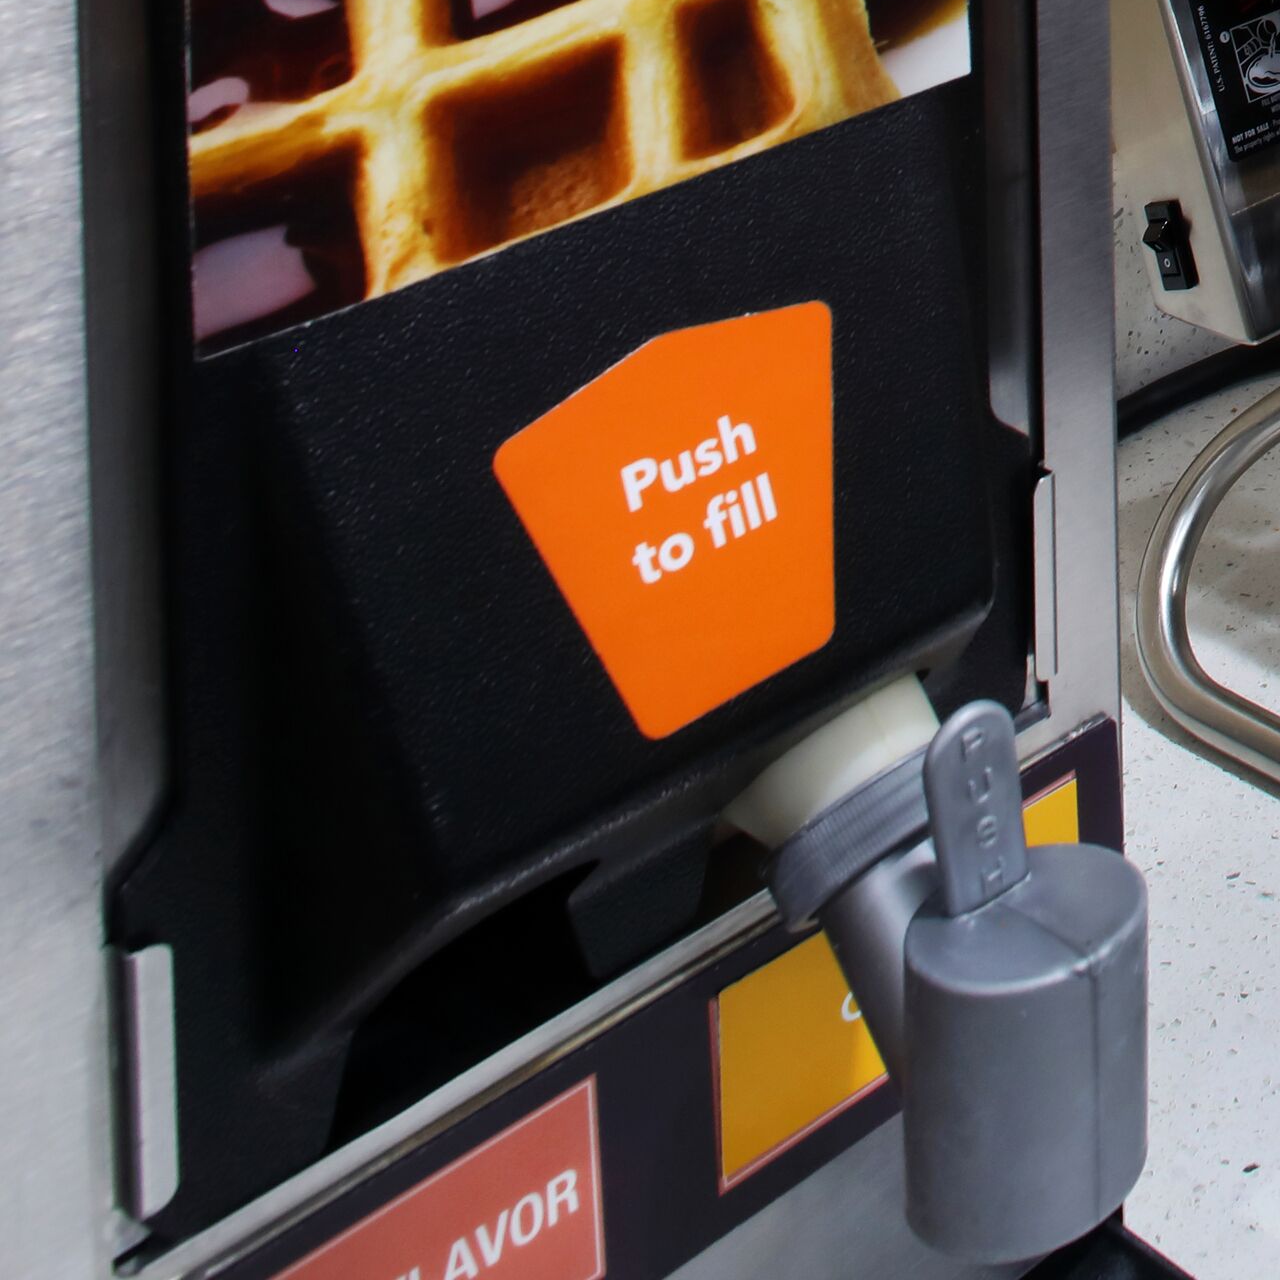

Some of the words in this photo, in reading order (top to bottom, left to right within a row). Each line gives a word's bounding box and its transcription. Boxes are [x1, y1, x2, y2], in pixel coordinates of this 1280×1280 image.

[1197, 4, 1213, 40] 6167796
[1207, 40, 1221, 75] PATENT:
[1216, 74, 1226, 93] U.S.
[1231, 132, 1244, 144] NOT
[1244, 127, 1256, 138] FOR
[1255, 121, 1269, 134] SALE
[620, 414, 757, 513] Push
[631, 532, 695, 584] to
[703, 471, 779, 549] fill
[394, 1168, 580, 1280] AVOR
